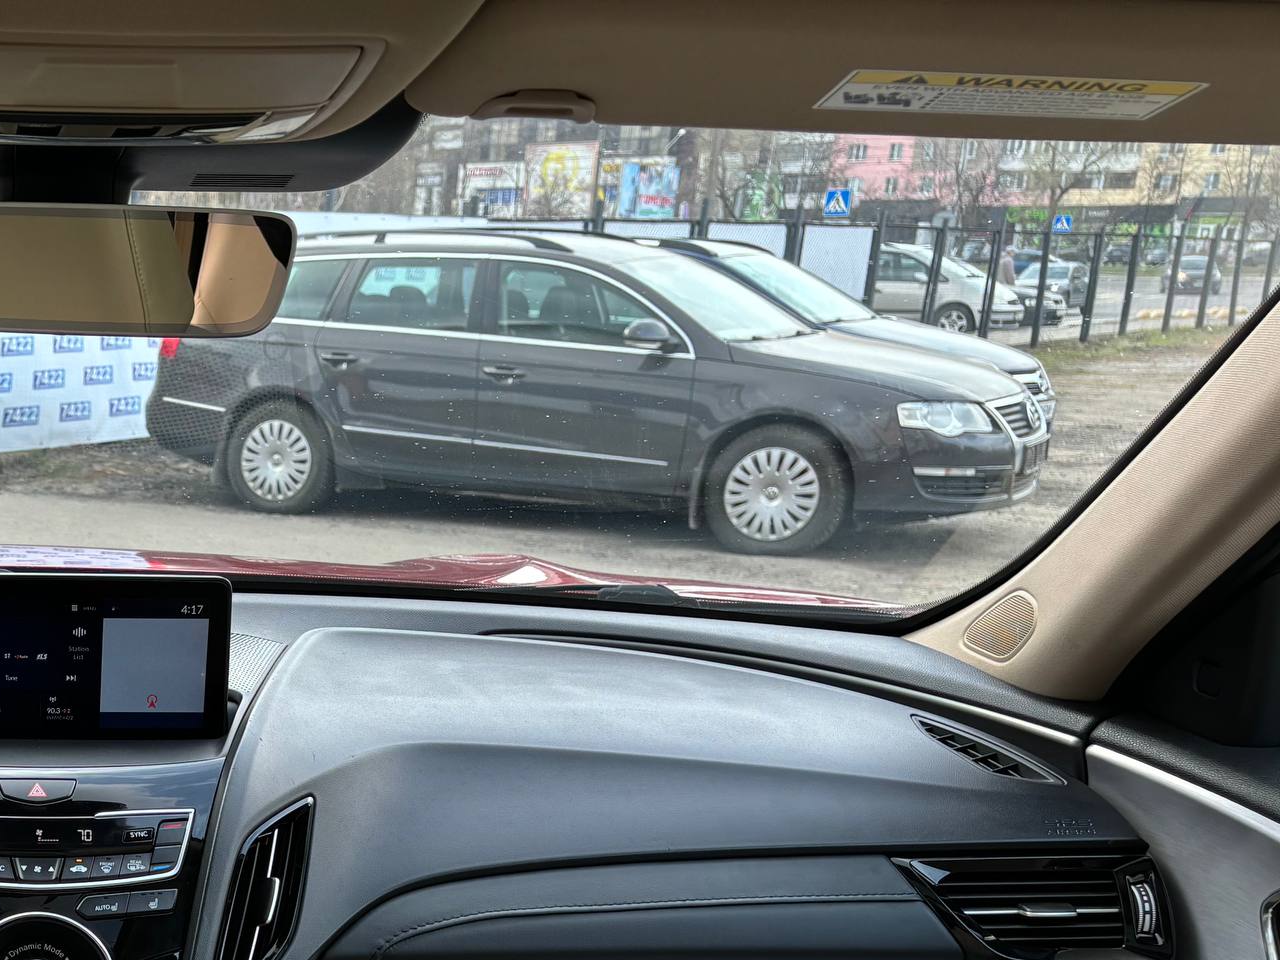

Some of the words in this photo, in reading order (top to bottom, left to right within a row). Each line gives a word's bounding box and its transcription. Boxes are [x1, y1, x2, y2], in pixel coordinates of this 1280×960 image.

[956, 76, 1147, 92] WARNING
[2, 338, 33, 353] 7422
[34, 371, 65, 387] 7422
[85, 367, 112, 382] 7422
[61, 403, 90, 419] 7422
[111, 398, 140, 414] 7422
[4, 408, 39, 424] 7422
[180, 604, 205, 616] 4:17
[76, 829, 93, 842] 70
[129, 831, 149, 839] SYNC
[95, 904, 111, 912] AUTO
[8, 942, 42, 958] Dynamic
[43, 943, 66, 958] Mode
